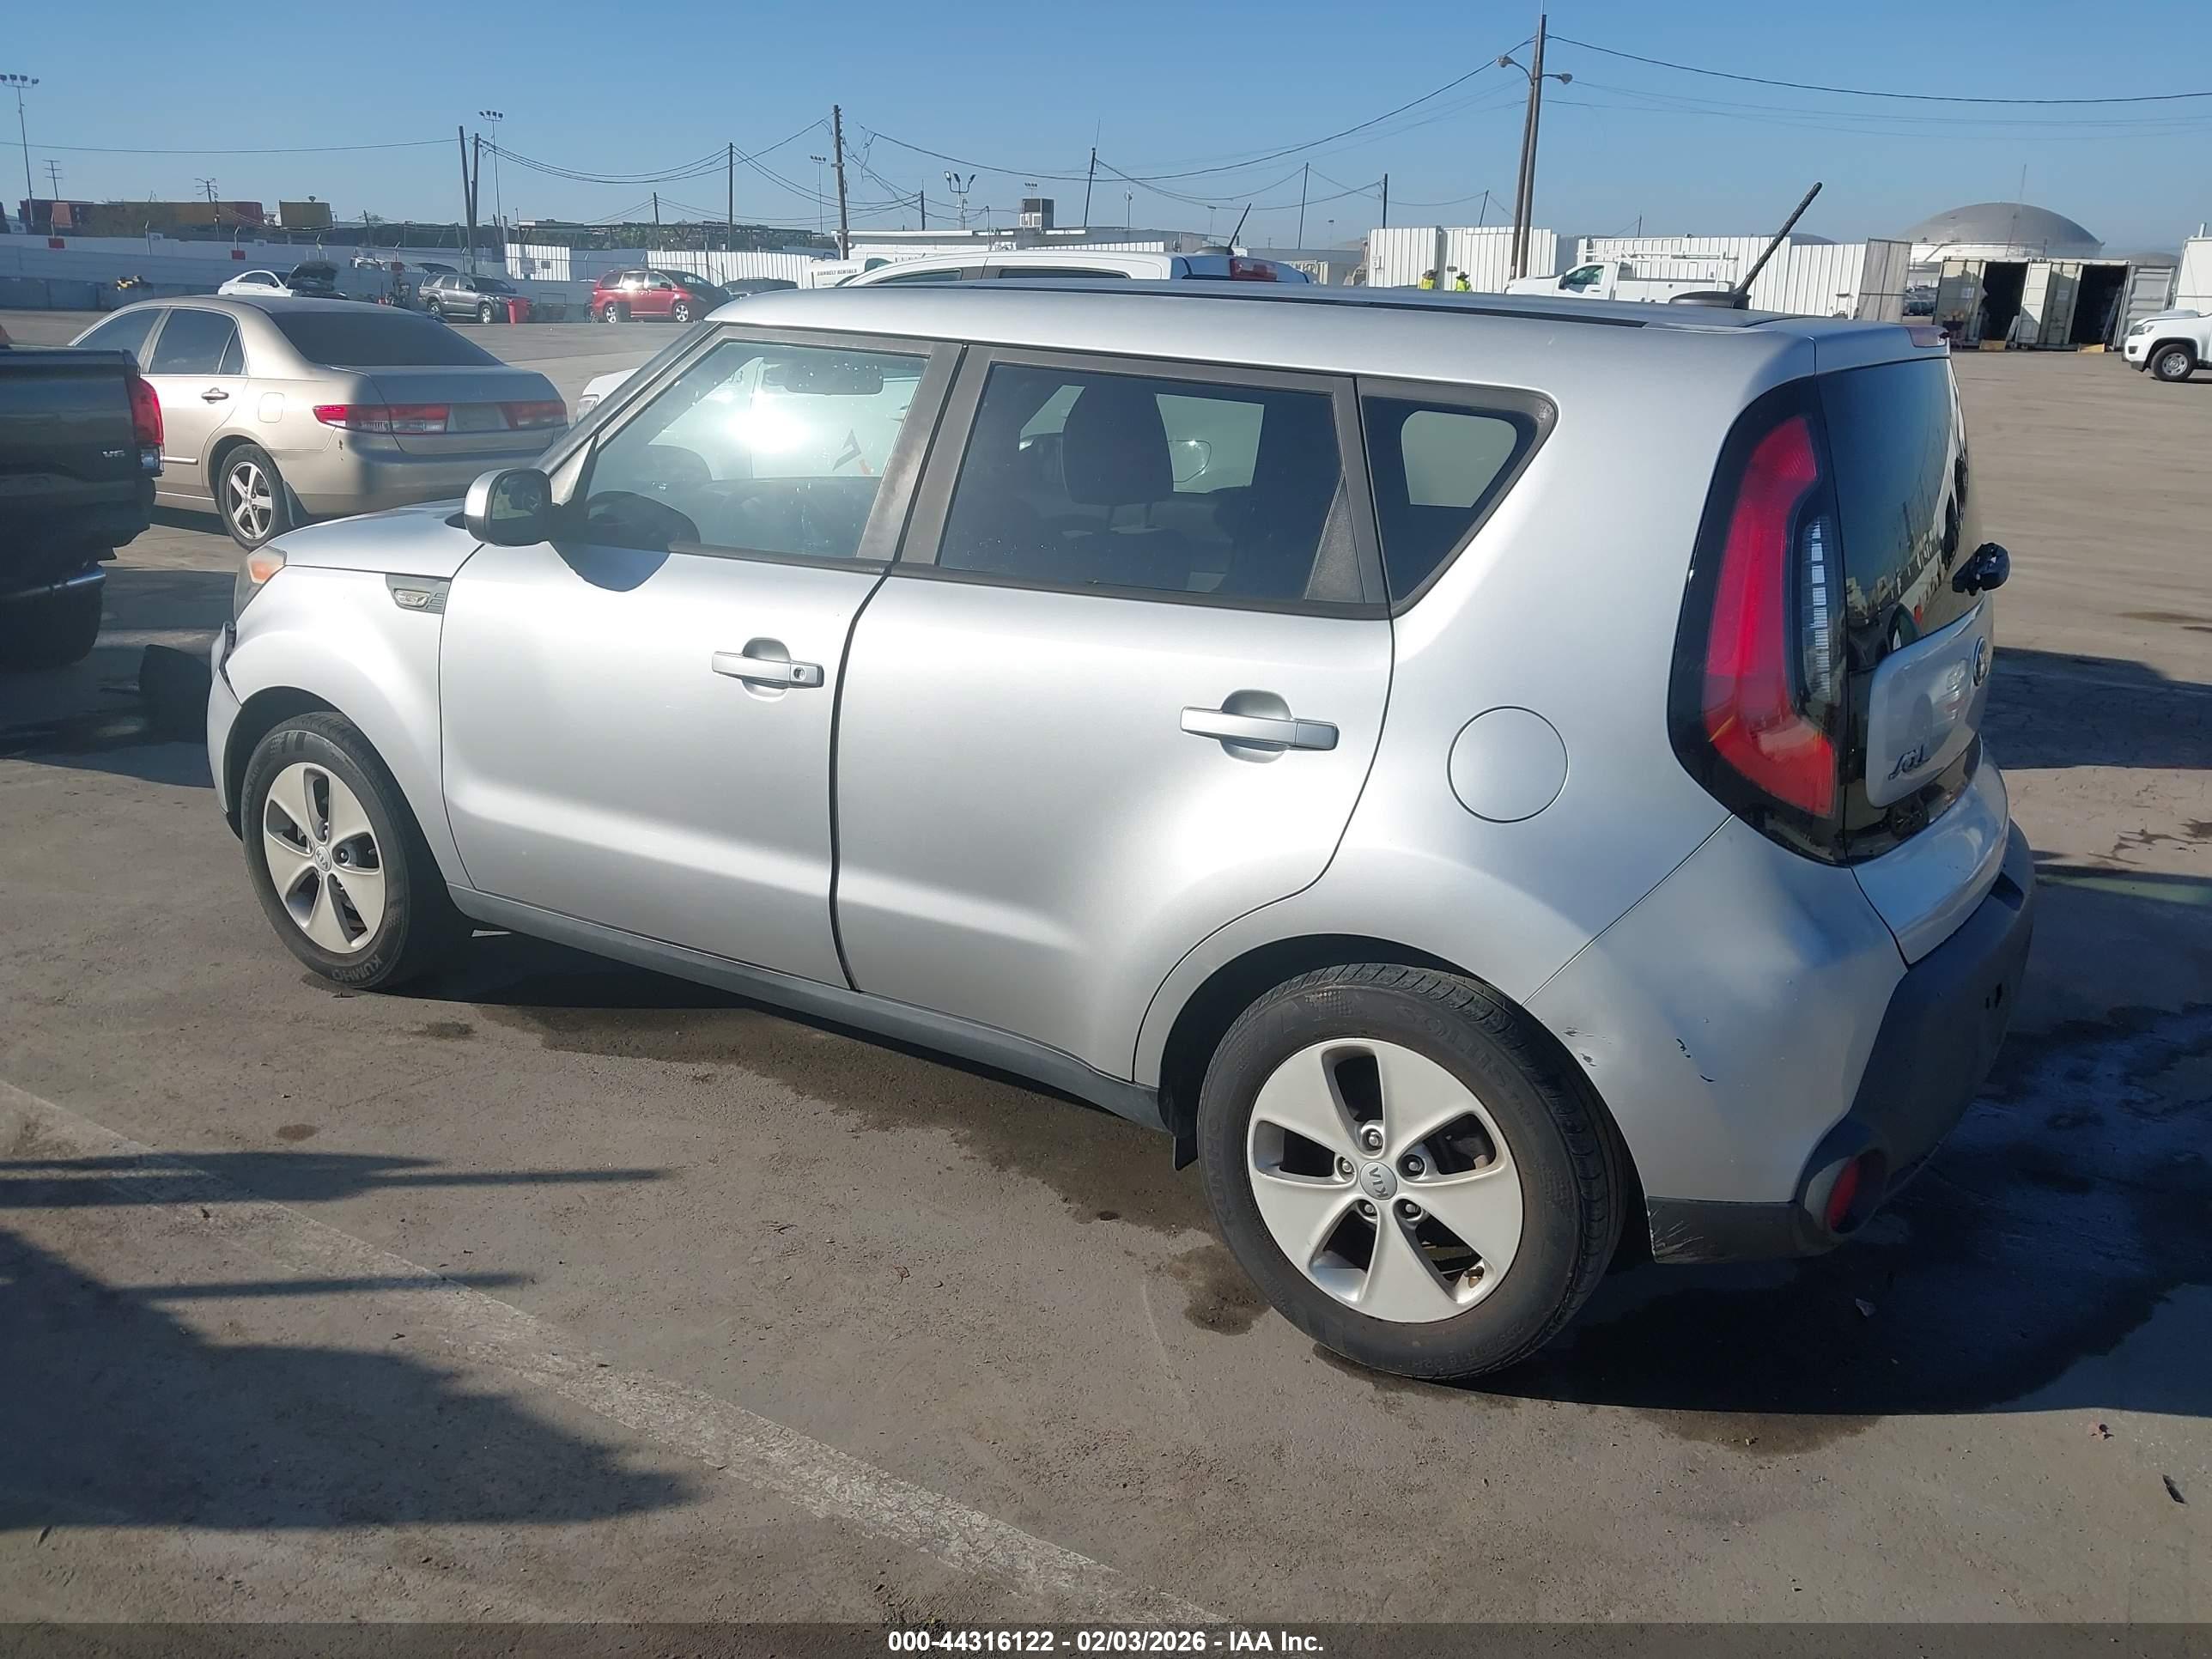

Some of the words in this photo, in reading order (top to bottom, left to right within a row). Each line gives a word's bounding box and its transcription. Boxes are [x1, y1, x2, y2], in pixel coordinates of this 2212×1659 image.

[316, 850, 328, 869] KIA
[331, 954, 383, 981] KUMHO
[1369, 1166, 1389, 1198] KIA
